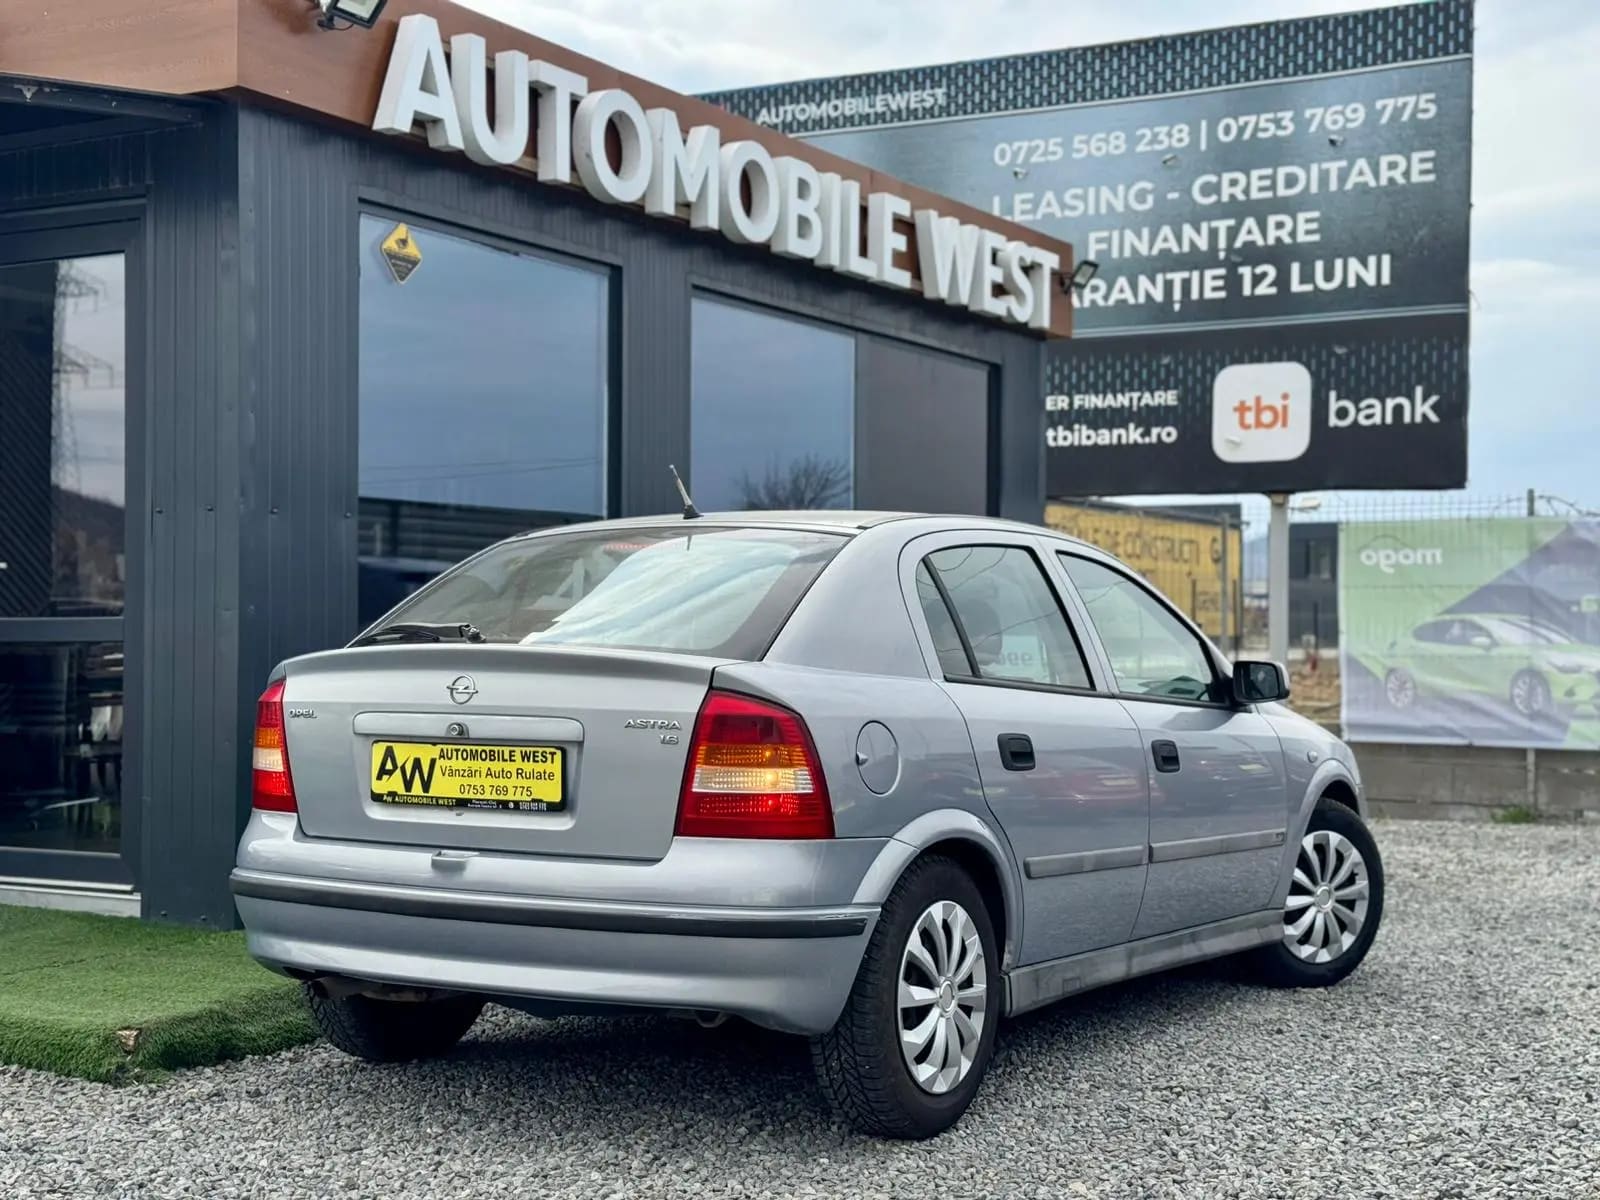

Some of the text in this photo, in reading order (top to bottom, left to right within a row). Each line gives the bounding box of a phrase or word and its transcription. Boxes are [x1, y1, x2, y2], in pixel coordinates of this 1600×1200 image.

[757, 87, 948, 125] AUTOMOBILEWEST
[993, 137, 1064, 166] 0725
[1072, 131, 1126, 159] 568
[1135, 123, 1190, 153] 238
[1217, 110, 1295, 142] 0753
[1304, 103, 1366, 133] 769
[1375, 93, 1437, 125] 775
[372, 13, 1060, 328] AUTOMOBILE WEST
[992, 180, 1155, 222] LEASING
[1191, 150, 1437, 204] CREDITARE
[1087, 211, 1321, 260] FINANȚARE
[1238, 262, 1277, 296] 12
[1290, 254, 1392, 293] LUNI
[1073, 390, 1178, 411] FINANȚARE
[1232, 385, 1440, 430] tbi bank
[1046, 422, 1178, 447] tbibank.ro
[289, 709, 318, 719] OPEL
[624, 719, 681, 730] ASTRA
[438, 748, 557, 764] AUTOMOBILE WEST
[485, 767, 513, 780] Auto
[516, 769, 555, 781] Rulate
[395, 795, 436, 805] AUTOMOBILE
[459, 783, 533, 797] 0753 769 775
